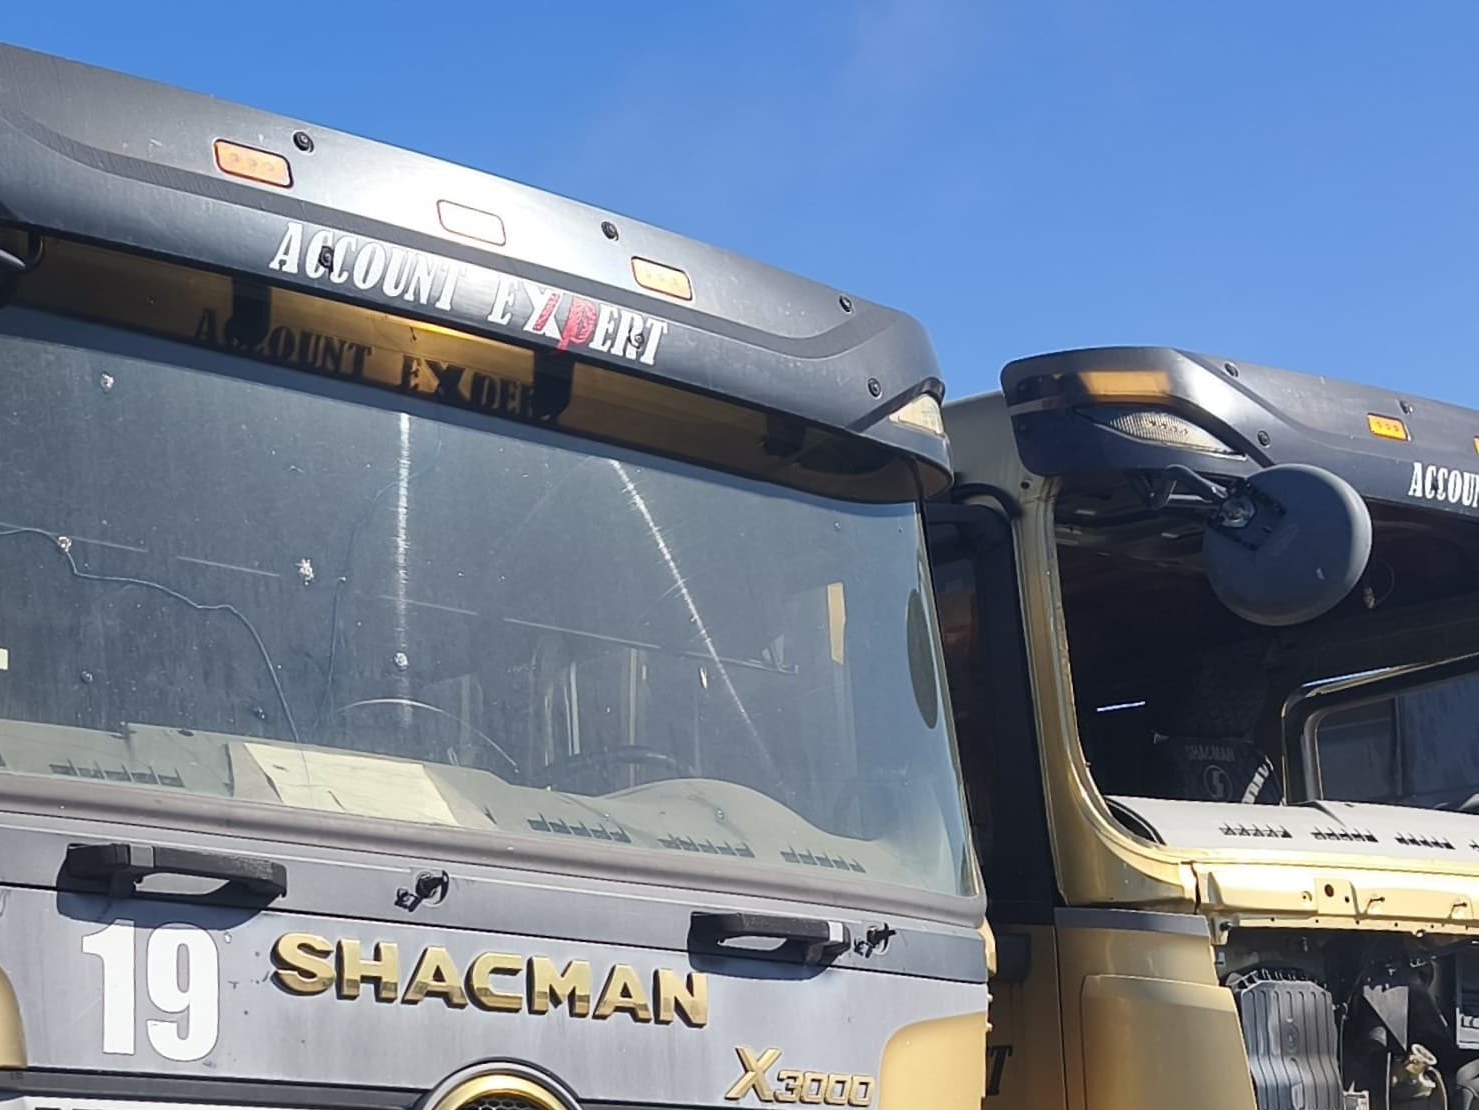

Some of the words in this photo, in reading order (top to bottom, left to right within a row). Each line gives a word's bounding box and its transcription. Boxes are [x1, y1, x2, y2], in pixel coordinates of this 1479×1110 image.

[269, 221, 465, 311] ACCOUNT
[488, 279, 668, 367] EXPERT
[81, 918, 220, 1062] 19
[270, 932, 709, 1029] SHACMAN
[724, 1046, 876, 1107] X3000
